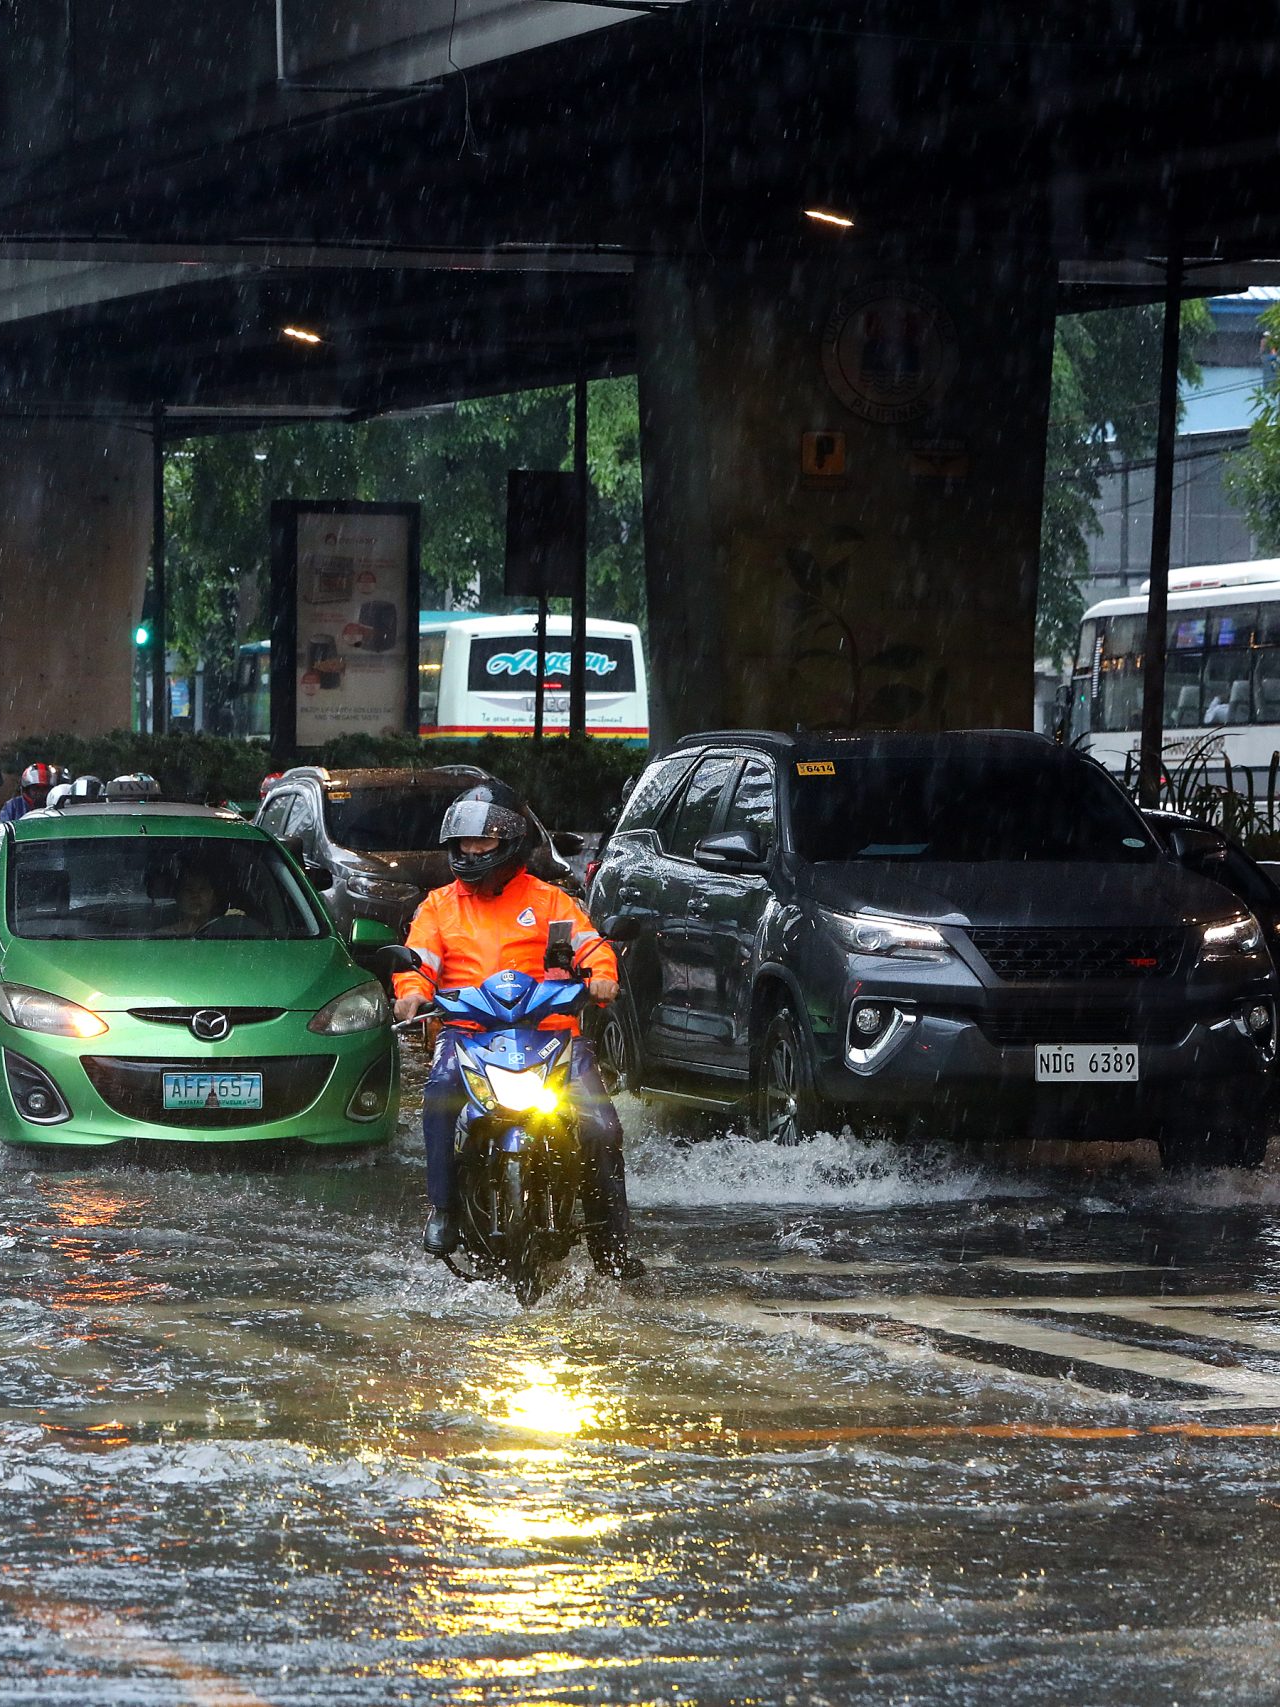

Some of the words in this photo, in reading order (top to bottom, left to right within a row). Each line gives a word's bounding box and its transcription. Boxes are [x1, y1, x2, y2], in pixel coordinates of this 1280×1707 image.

[486, 649, 617, 675] Angean
[525, 699, 570, 711] IEC
[119, 783, 149, 791] TAXI
[1040, 1053, 1074, 1073] NDG
[1089, 1053, 1135, 1073] 6389
[172, 1079, 208, 1098] AFF
[218, 1079, 256, 1098] 657
